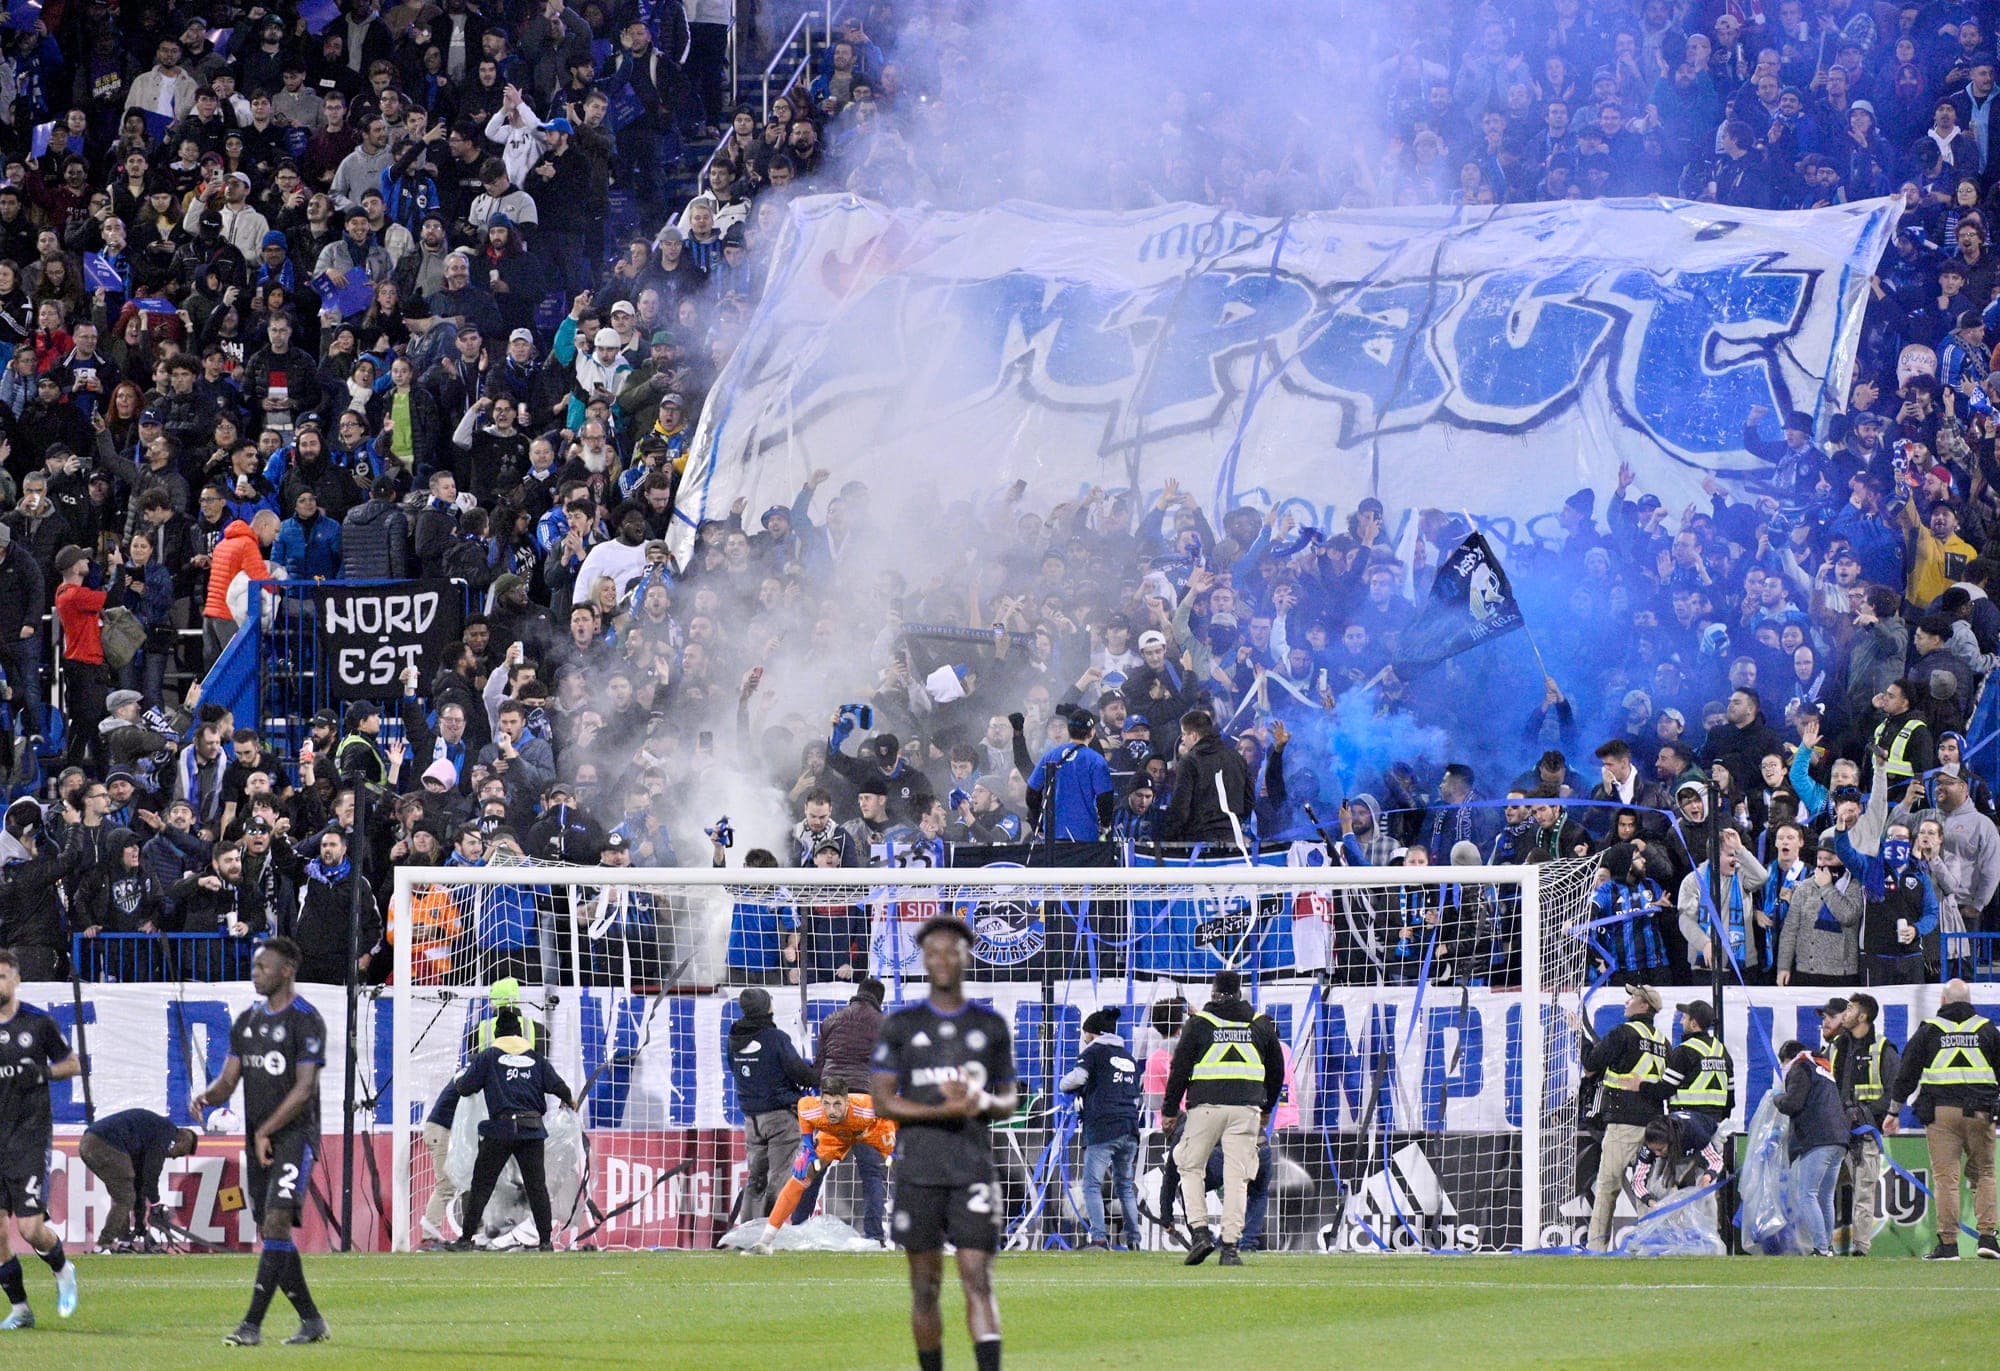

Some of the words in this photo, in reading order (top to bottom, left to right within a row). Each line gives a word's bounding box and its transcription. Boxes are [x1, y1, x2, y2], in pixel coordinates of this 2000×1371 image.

[325, 591, 439, 634] NORD
[338, 643, 423, 684] EST
[1201, 903, 1280, 942] MONTRAL
[277, 1163, 300, 1191] 2
[606, 1156, 751, 1233] PRINGLE
[1317, 1213, 1480, 1253] adidas
